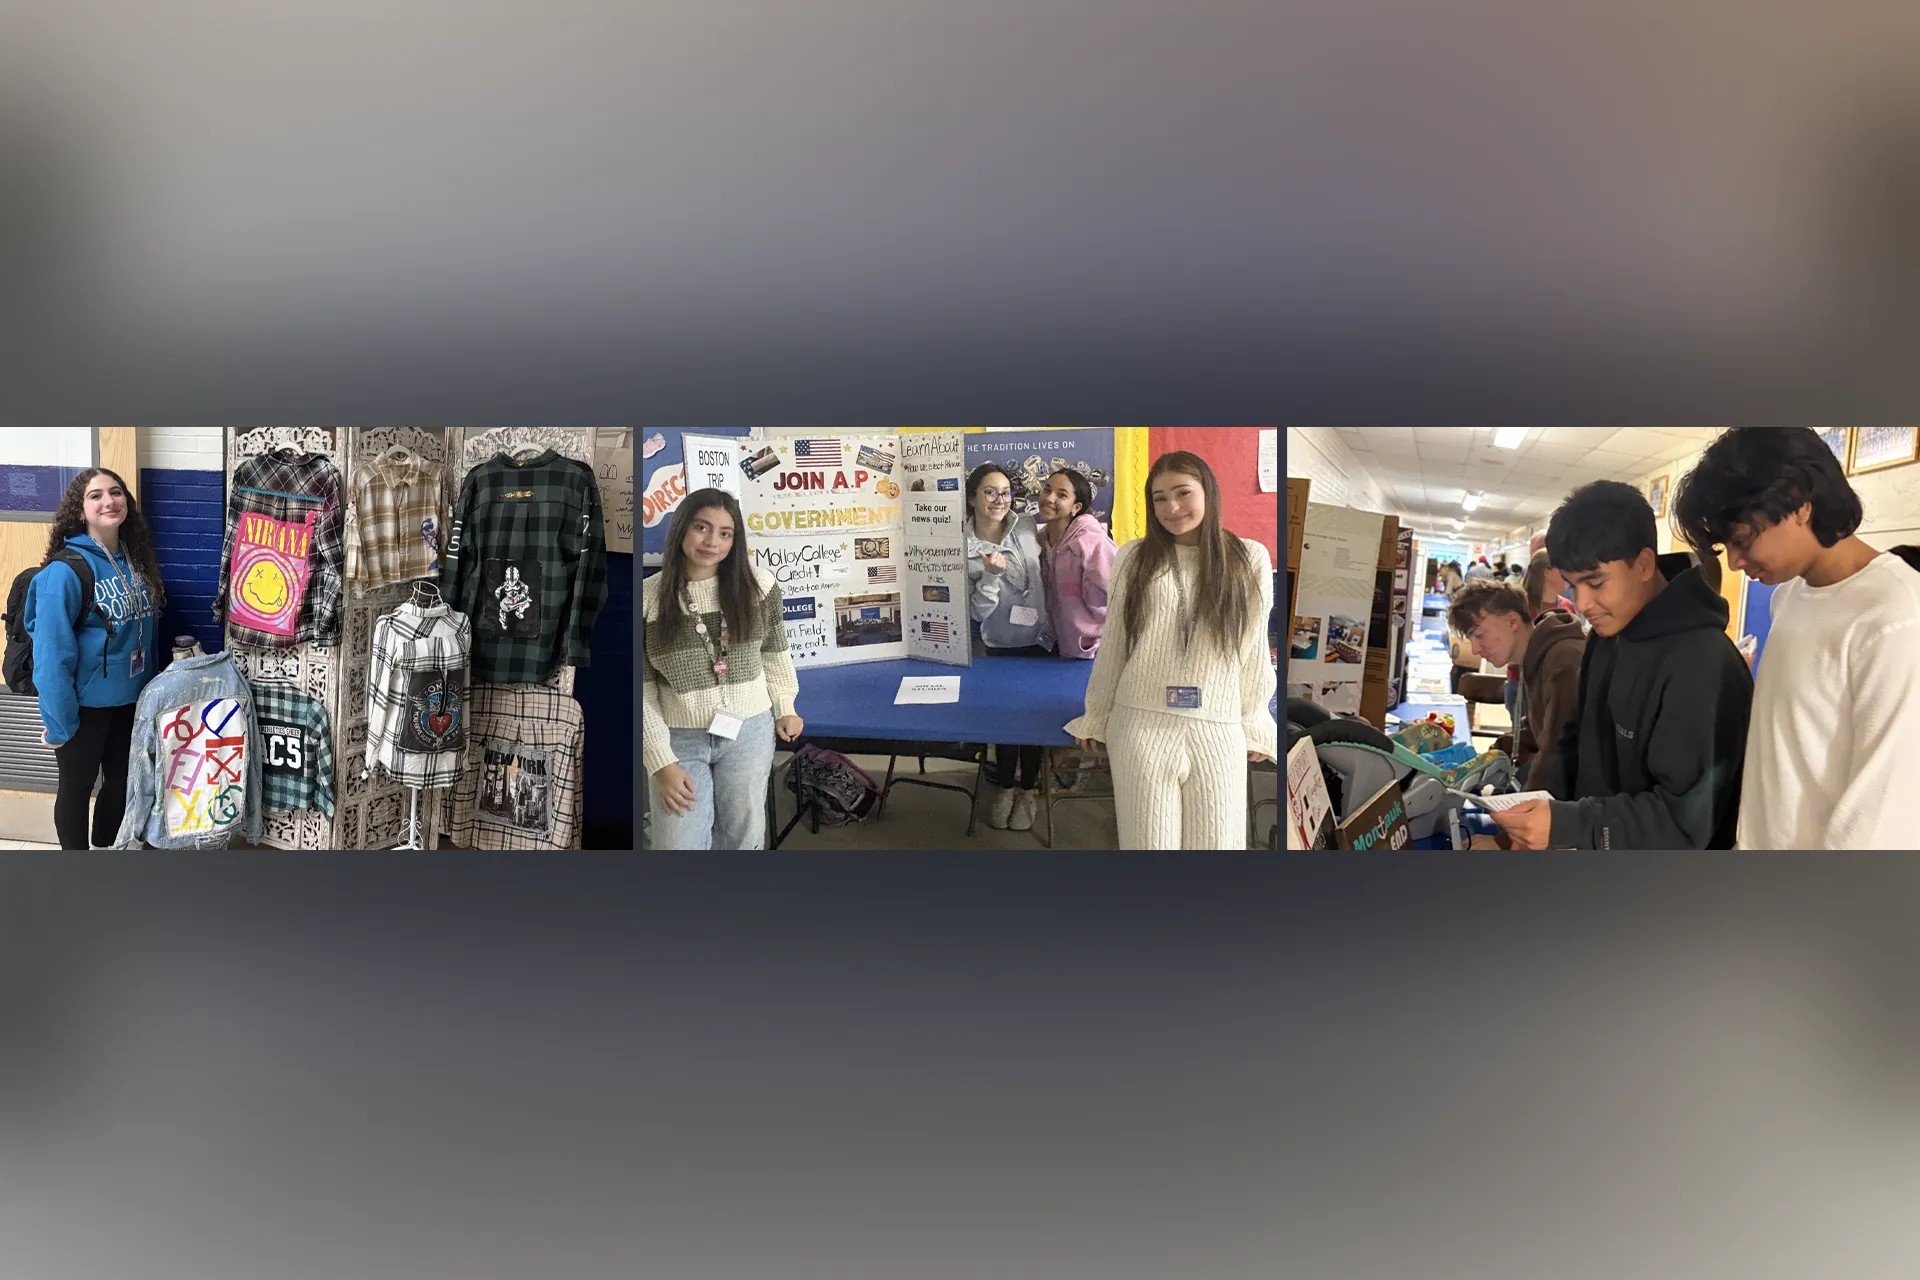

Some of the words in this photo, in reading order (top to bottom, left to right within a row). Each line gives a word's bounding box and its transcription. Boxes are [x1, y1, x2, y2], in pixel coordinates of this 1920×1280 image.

[900, 441, 930, 458] Learn
[931, 440, 960, 455] About
[966, 444, 979, 453] HE
[982, 442, 1030, 452] TRADITION
[1033, 440, 1059, 450] LIVES
[1062, 440, 1076, 449] ON
[698, 450, 730, 467] BOSTON
[707, 474, 725, 489] TRIP
[773, 471, 825, 490] JOIN
[643, 468, 687, 525] DIREC
[915, 503, 932, 512] Take
[911, 515, 931, 523] news
[932, 515, 951, 524] quiz!
[241, 517, 308, 558] NIRVANA
[756, 547, 801, 567] Molloy
[801, 545, 842, 562] College
[776, 564, 820, 583] Credit!
[788, 583, 811, 596] great
[783, 604, 813, 613] OLLEGE
[799, 623, 823, 638] Field
[1616, 723, 1634, 740] TIALS
[266, 735, 302, 769] C5
[484, 749, 514, 766] NEW
[1353, 801, 1402, 850] Montauk
